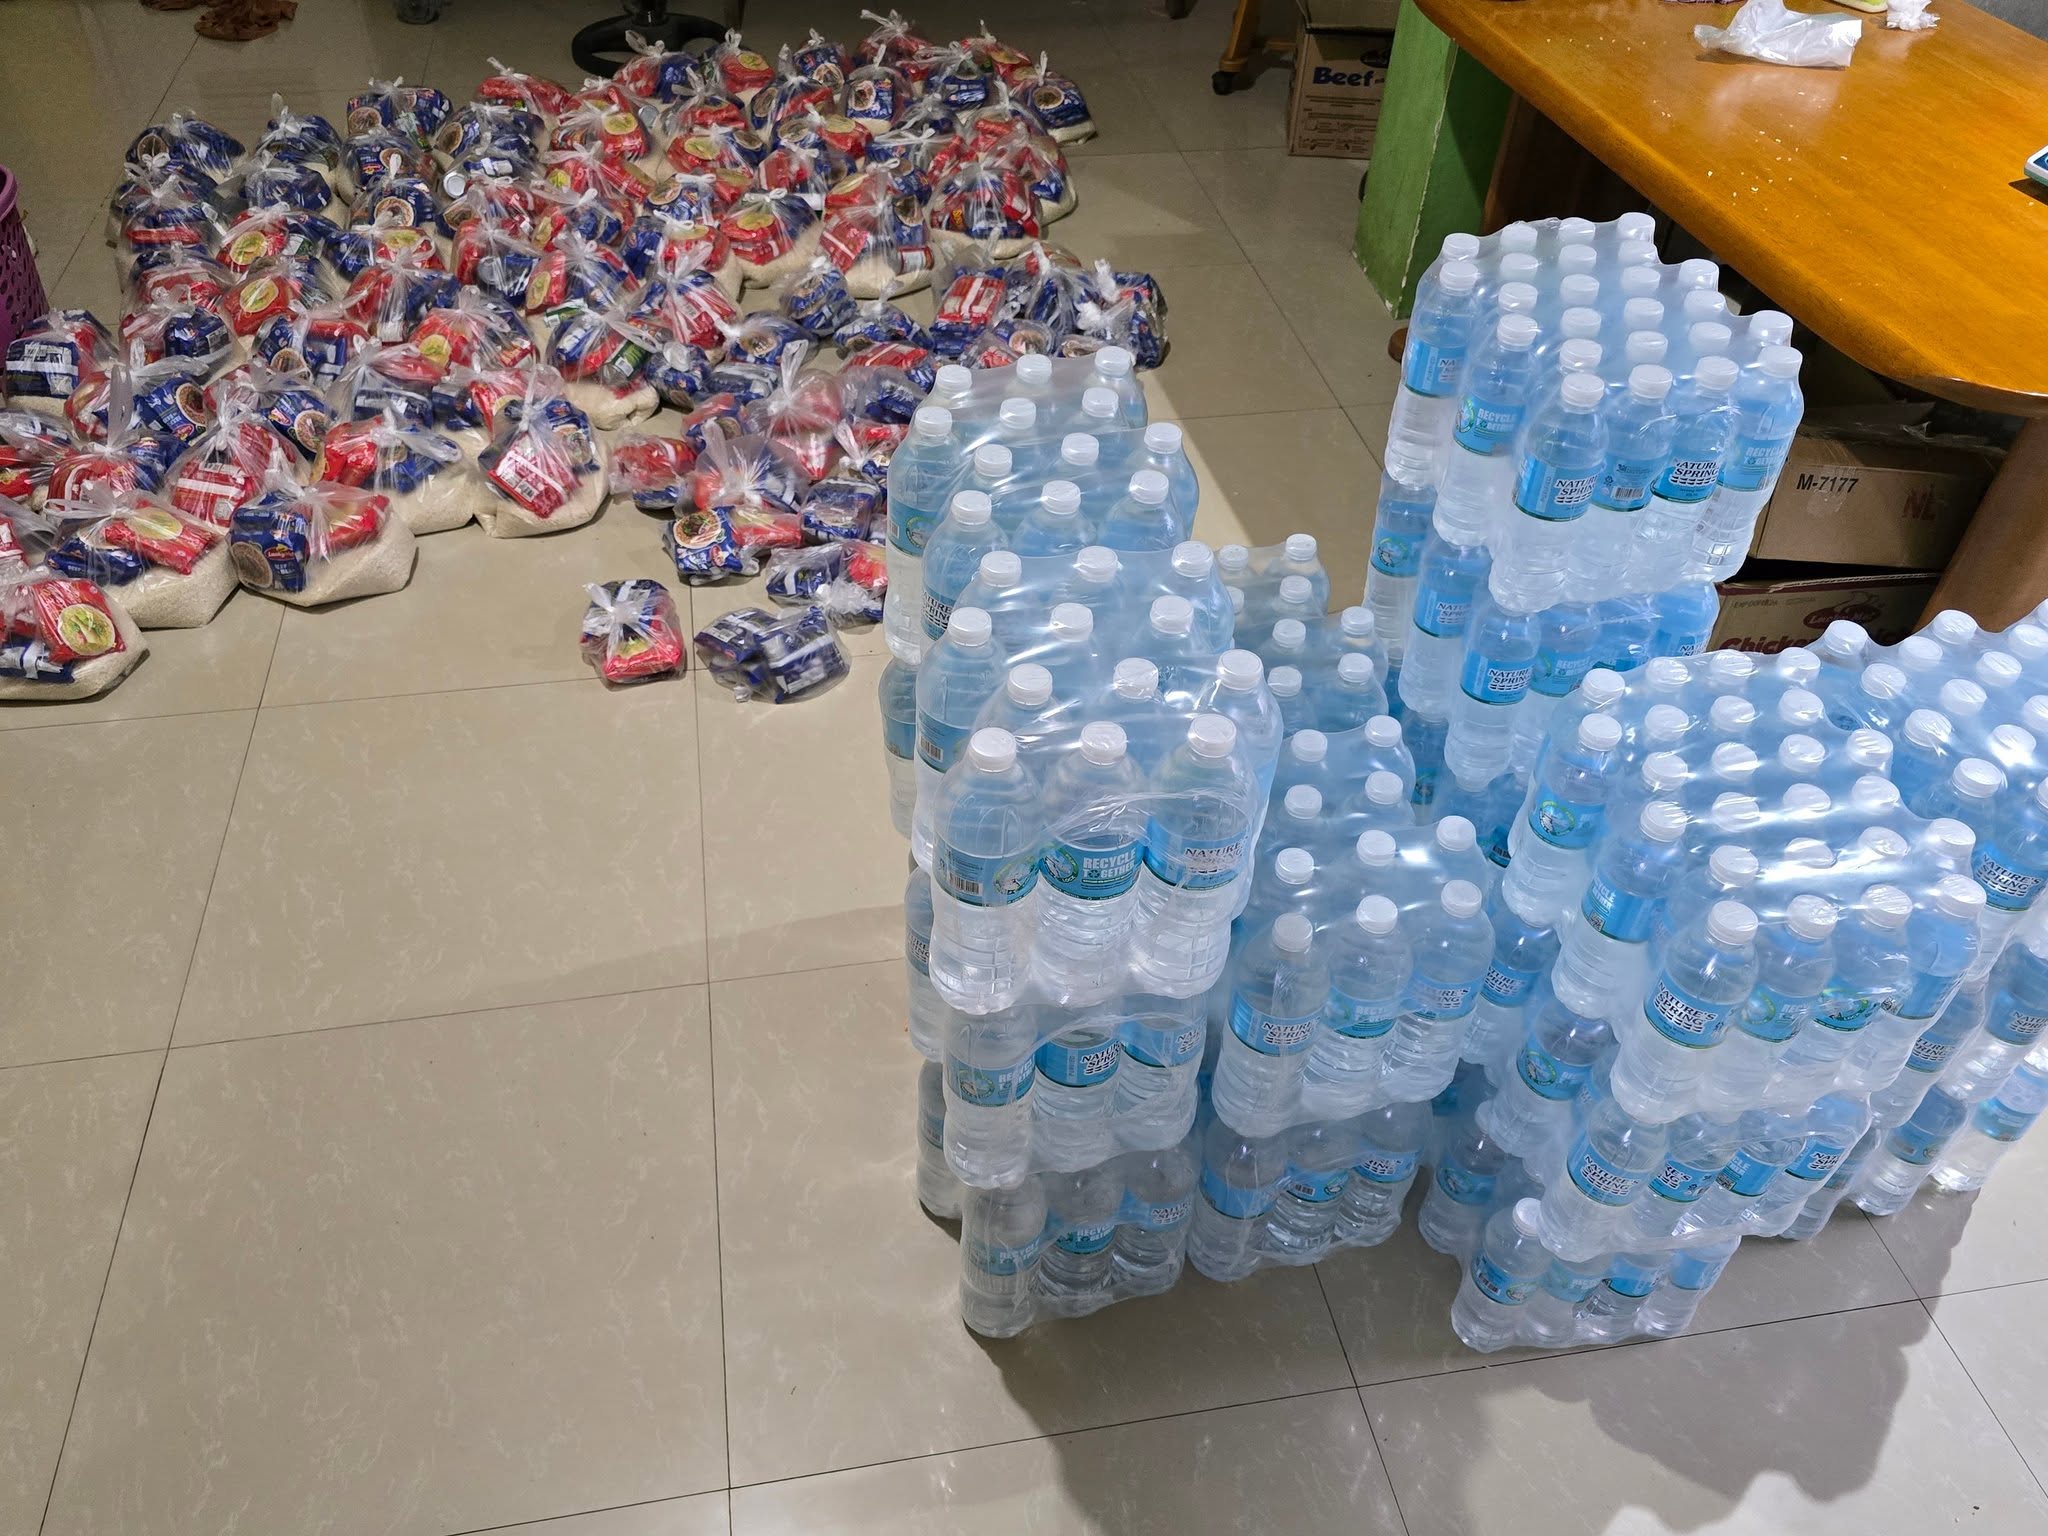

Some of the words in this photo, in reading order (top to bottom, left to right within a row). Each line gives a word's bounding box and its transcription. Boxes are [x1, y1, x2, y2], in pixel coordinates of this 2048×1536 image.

[1796, 473, 1860, 493] M-7177
[1083, 847, 1136, 869] RECYCLE
[1983, 854, 2042, 885] NATURE'S
[1982, 864, 2030, 891] SPRING
[1657, 993, 1704, 1026] SPRING
[1659, 981, 1718, 1021] NATURE'S
